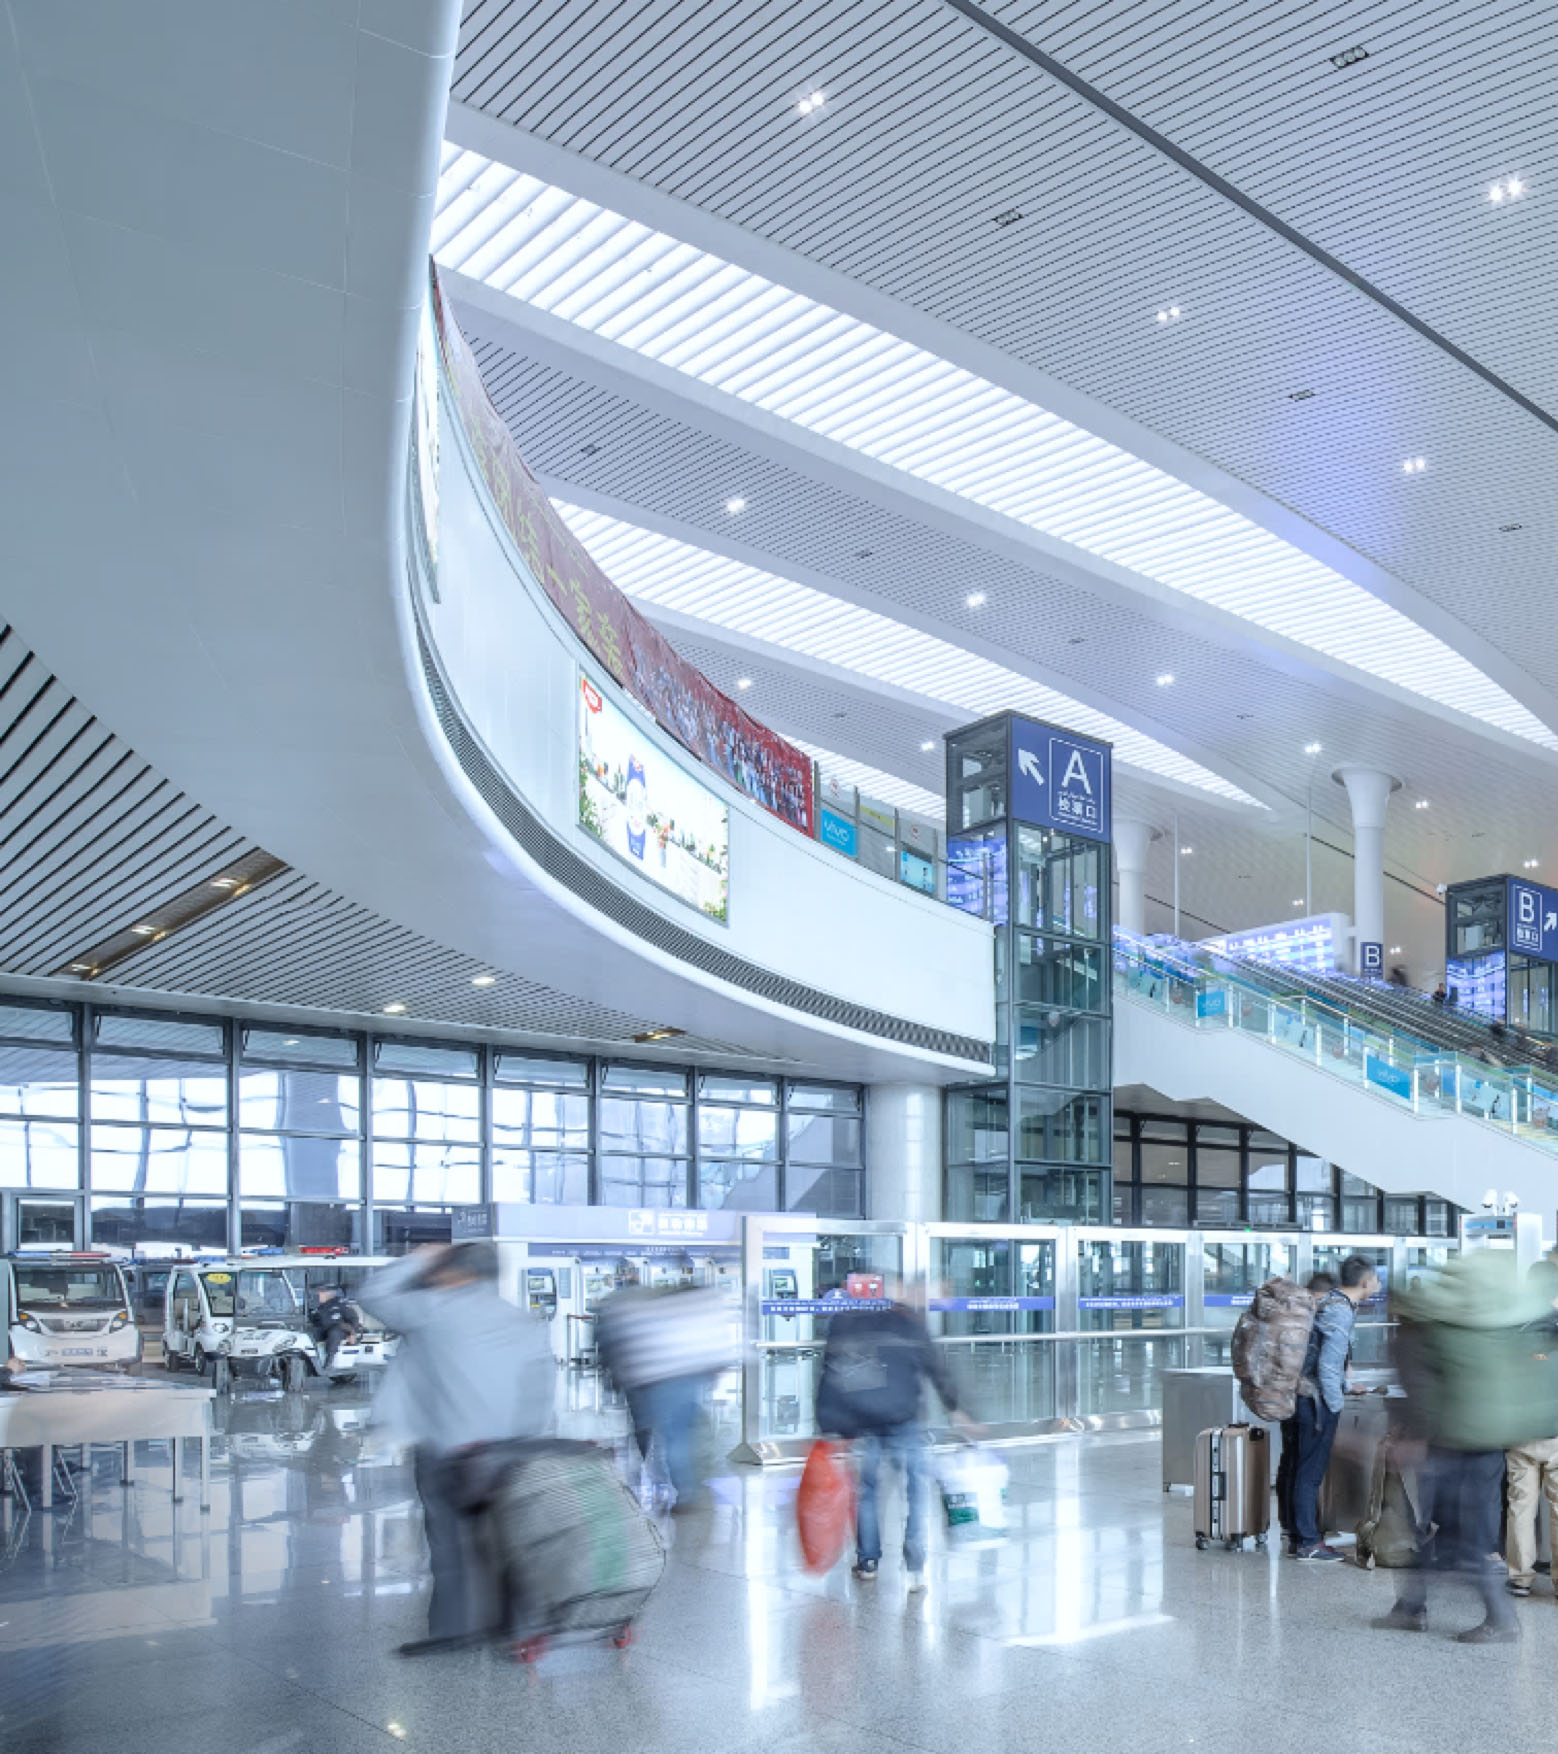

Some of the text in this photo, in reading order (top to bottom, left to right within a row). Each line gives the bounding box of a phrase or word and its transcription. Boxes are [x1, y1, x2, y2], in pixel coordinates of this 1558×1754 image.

[1061, 749, 1093, 795] A
[823, 818, 849, 842] vivo
[1519, 891, 1534, 922] B
[1366, 945, 1380, 965] B
